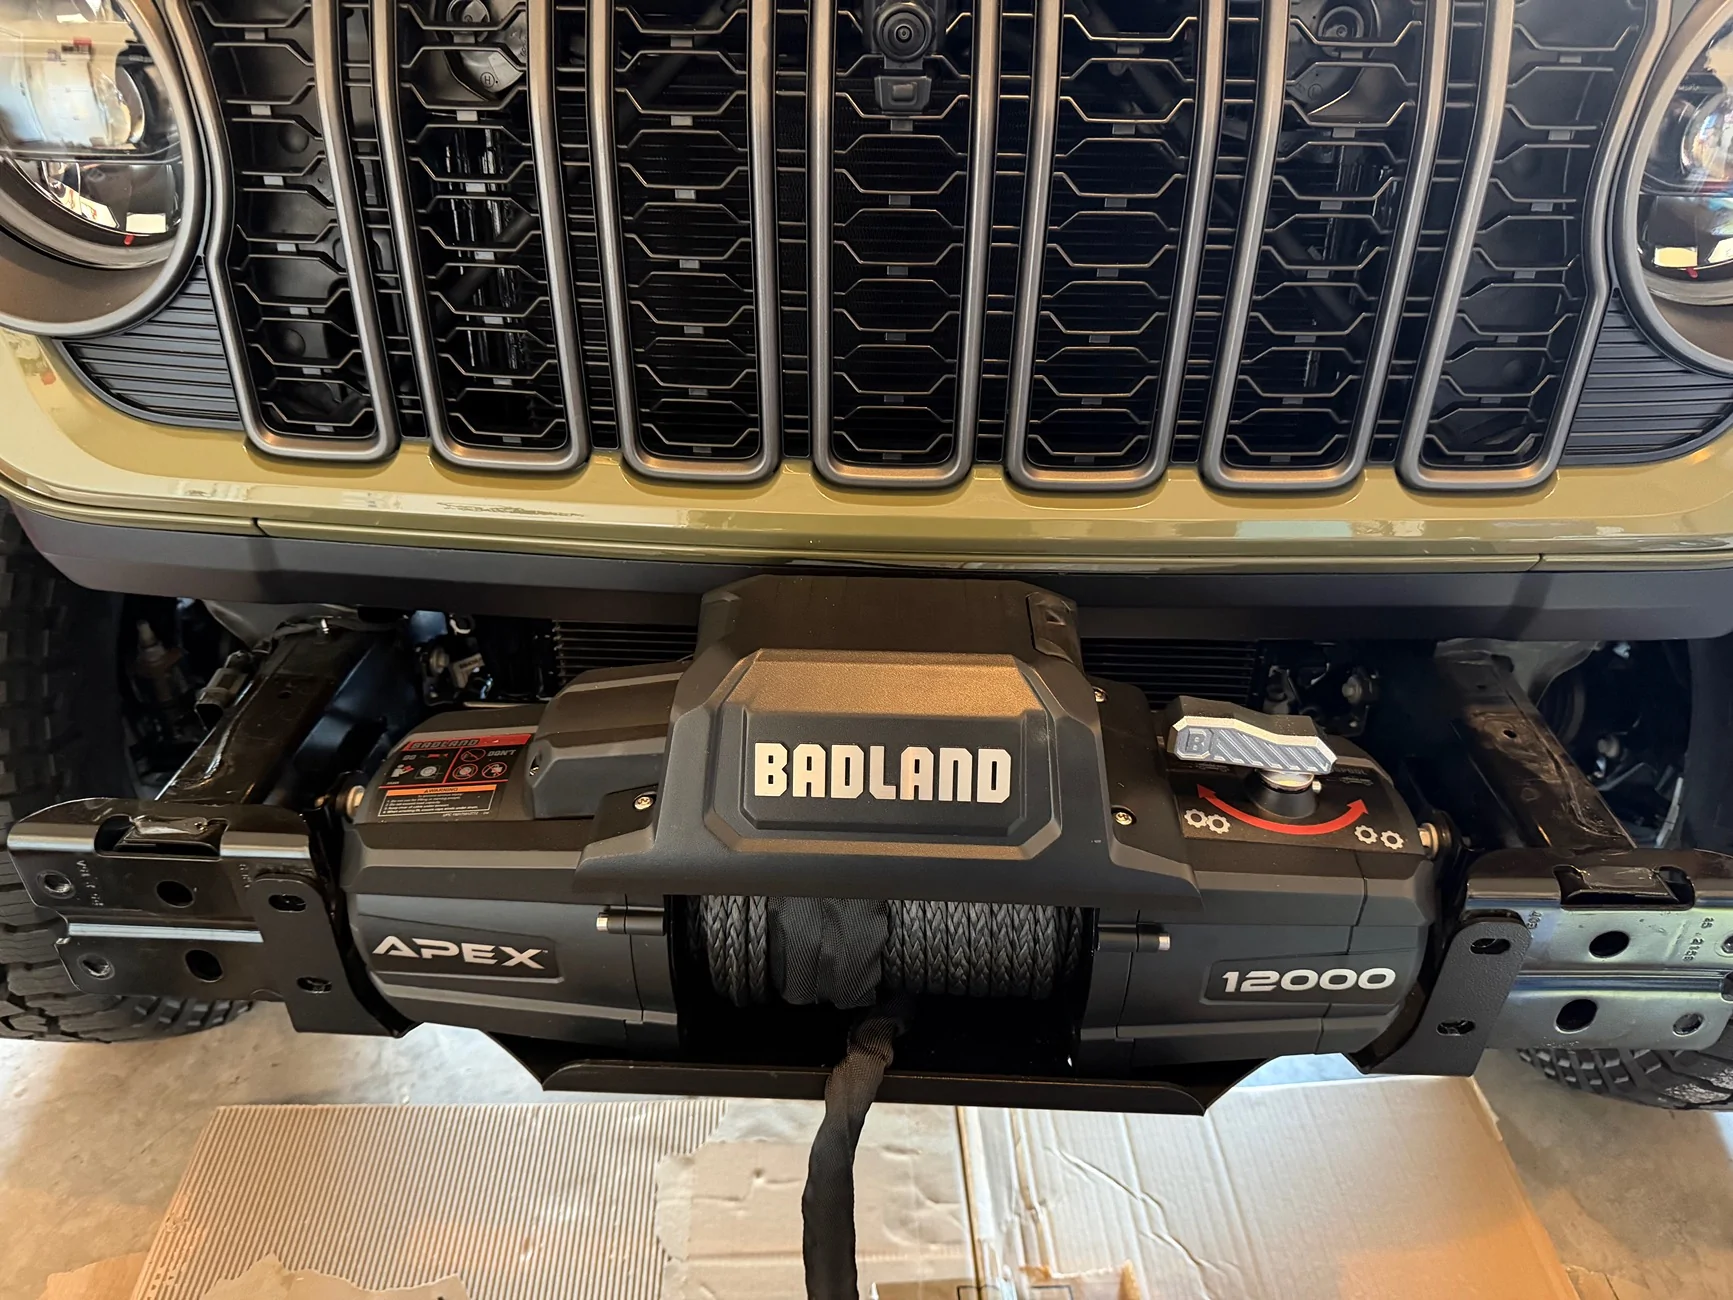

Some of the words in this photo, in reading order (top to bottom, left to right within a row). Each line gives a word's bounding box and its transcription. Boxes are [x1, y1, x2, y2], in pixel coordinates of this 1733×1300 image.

[487, 749, 516, 757] DON'T
[754, 742, 1012, 804] BADLAND
[372, 935, 546, 969] APEX
[1222, 967, 1396, 993] 12000
